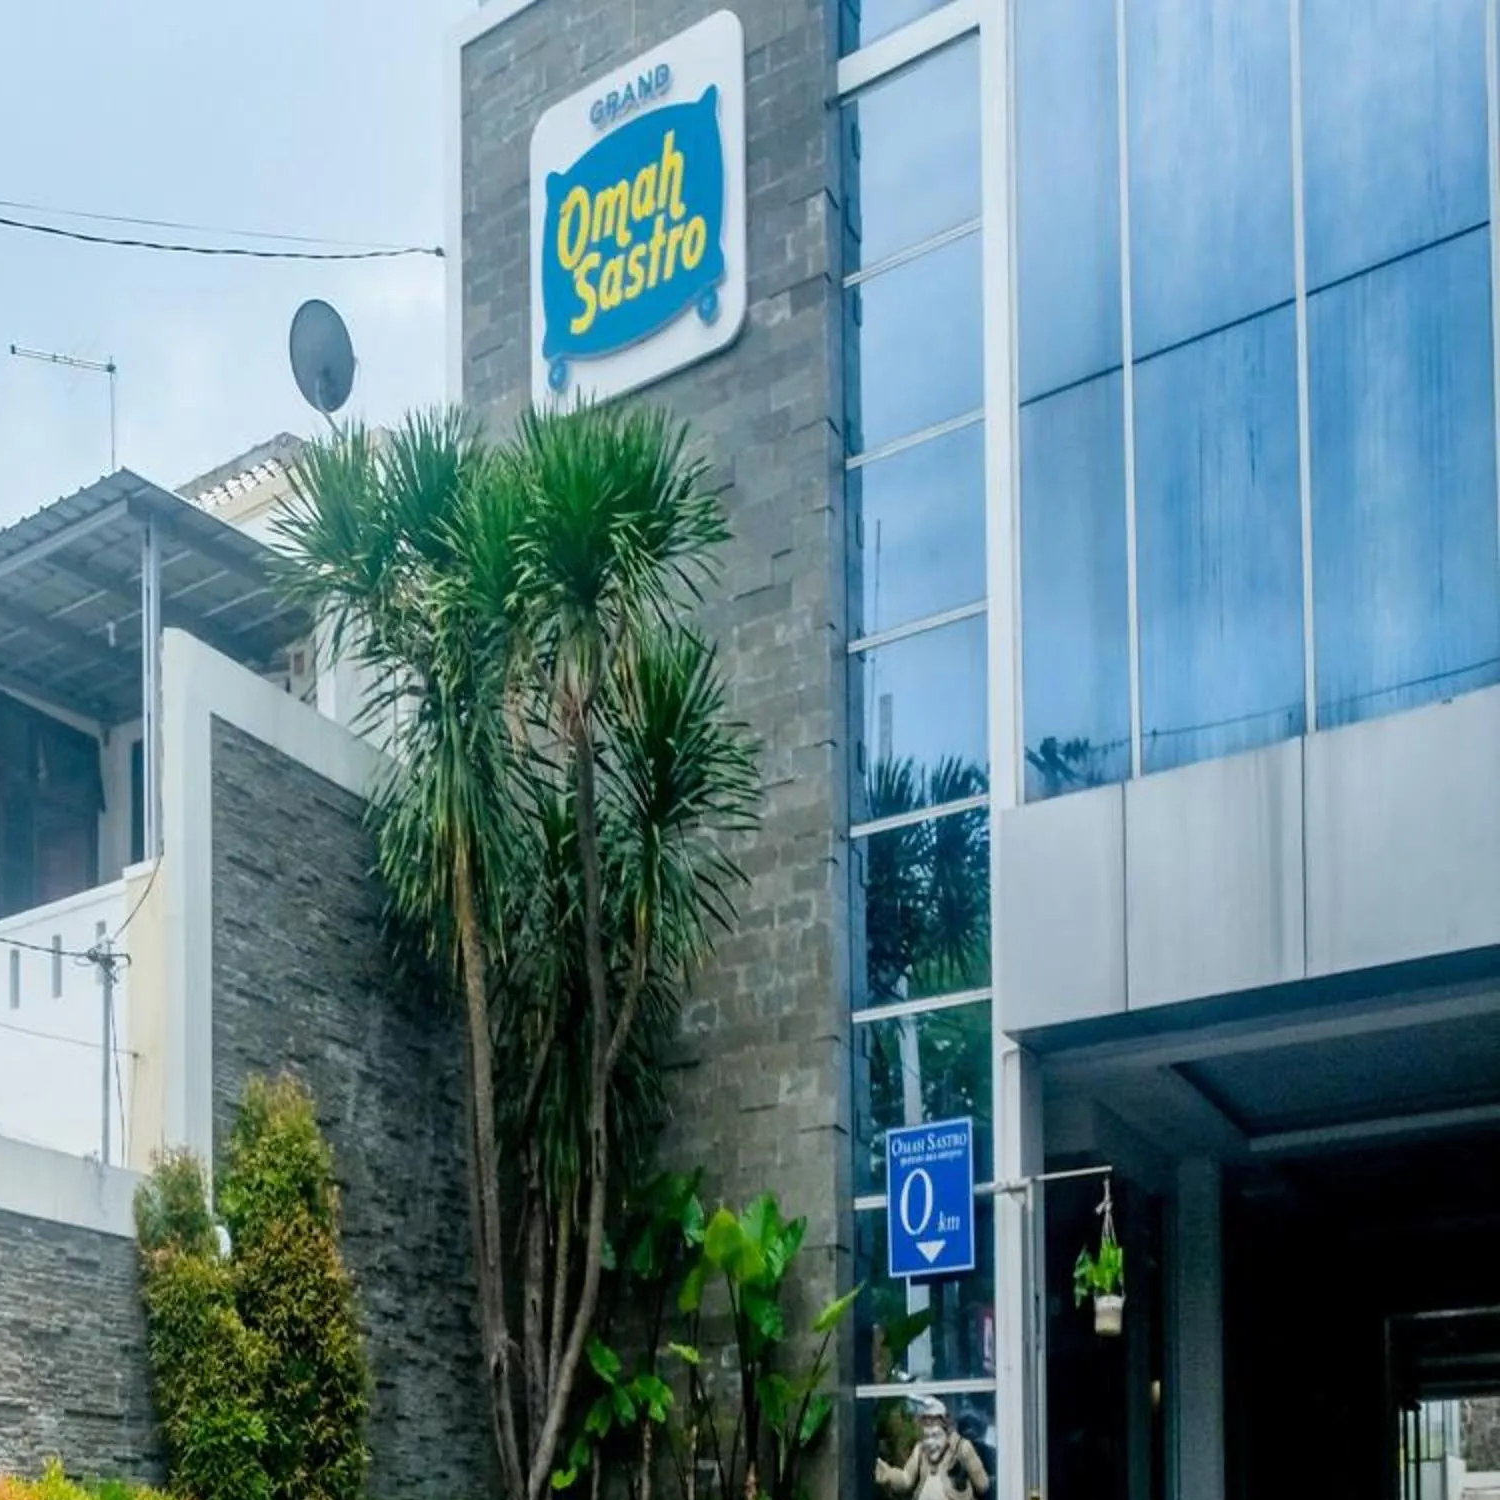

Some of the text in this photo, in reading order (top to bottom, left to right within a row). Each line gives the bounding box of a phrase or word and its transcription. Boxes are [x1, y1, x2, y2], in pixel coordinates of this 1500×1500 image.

[589, 63, 671, 125] GRAND
[558, 129, 686, 270] Omah
[570, 214, 707, 335] Sastro
[900, 1168, 933, 1235] 0
